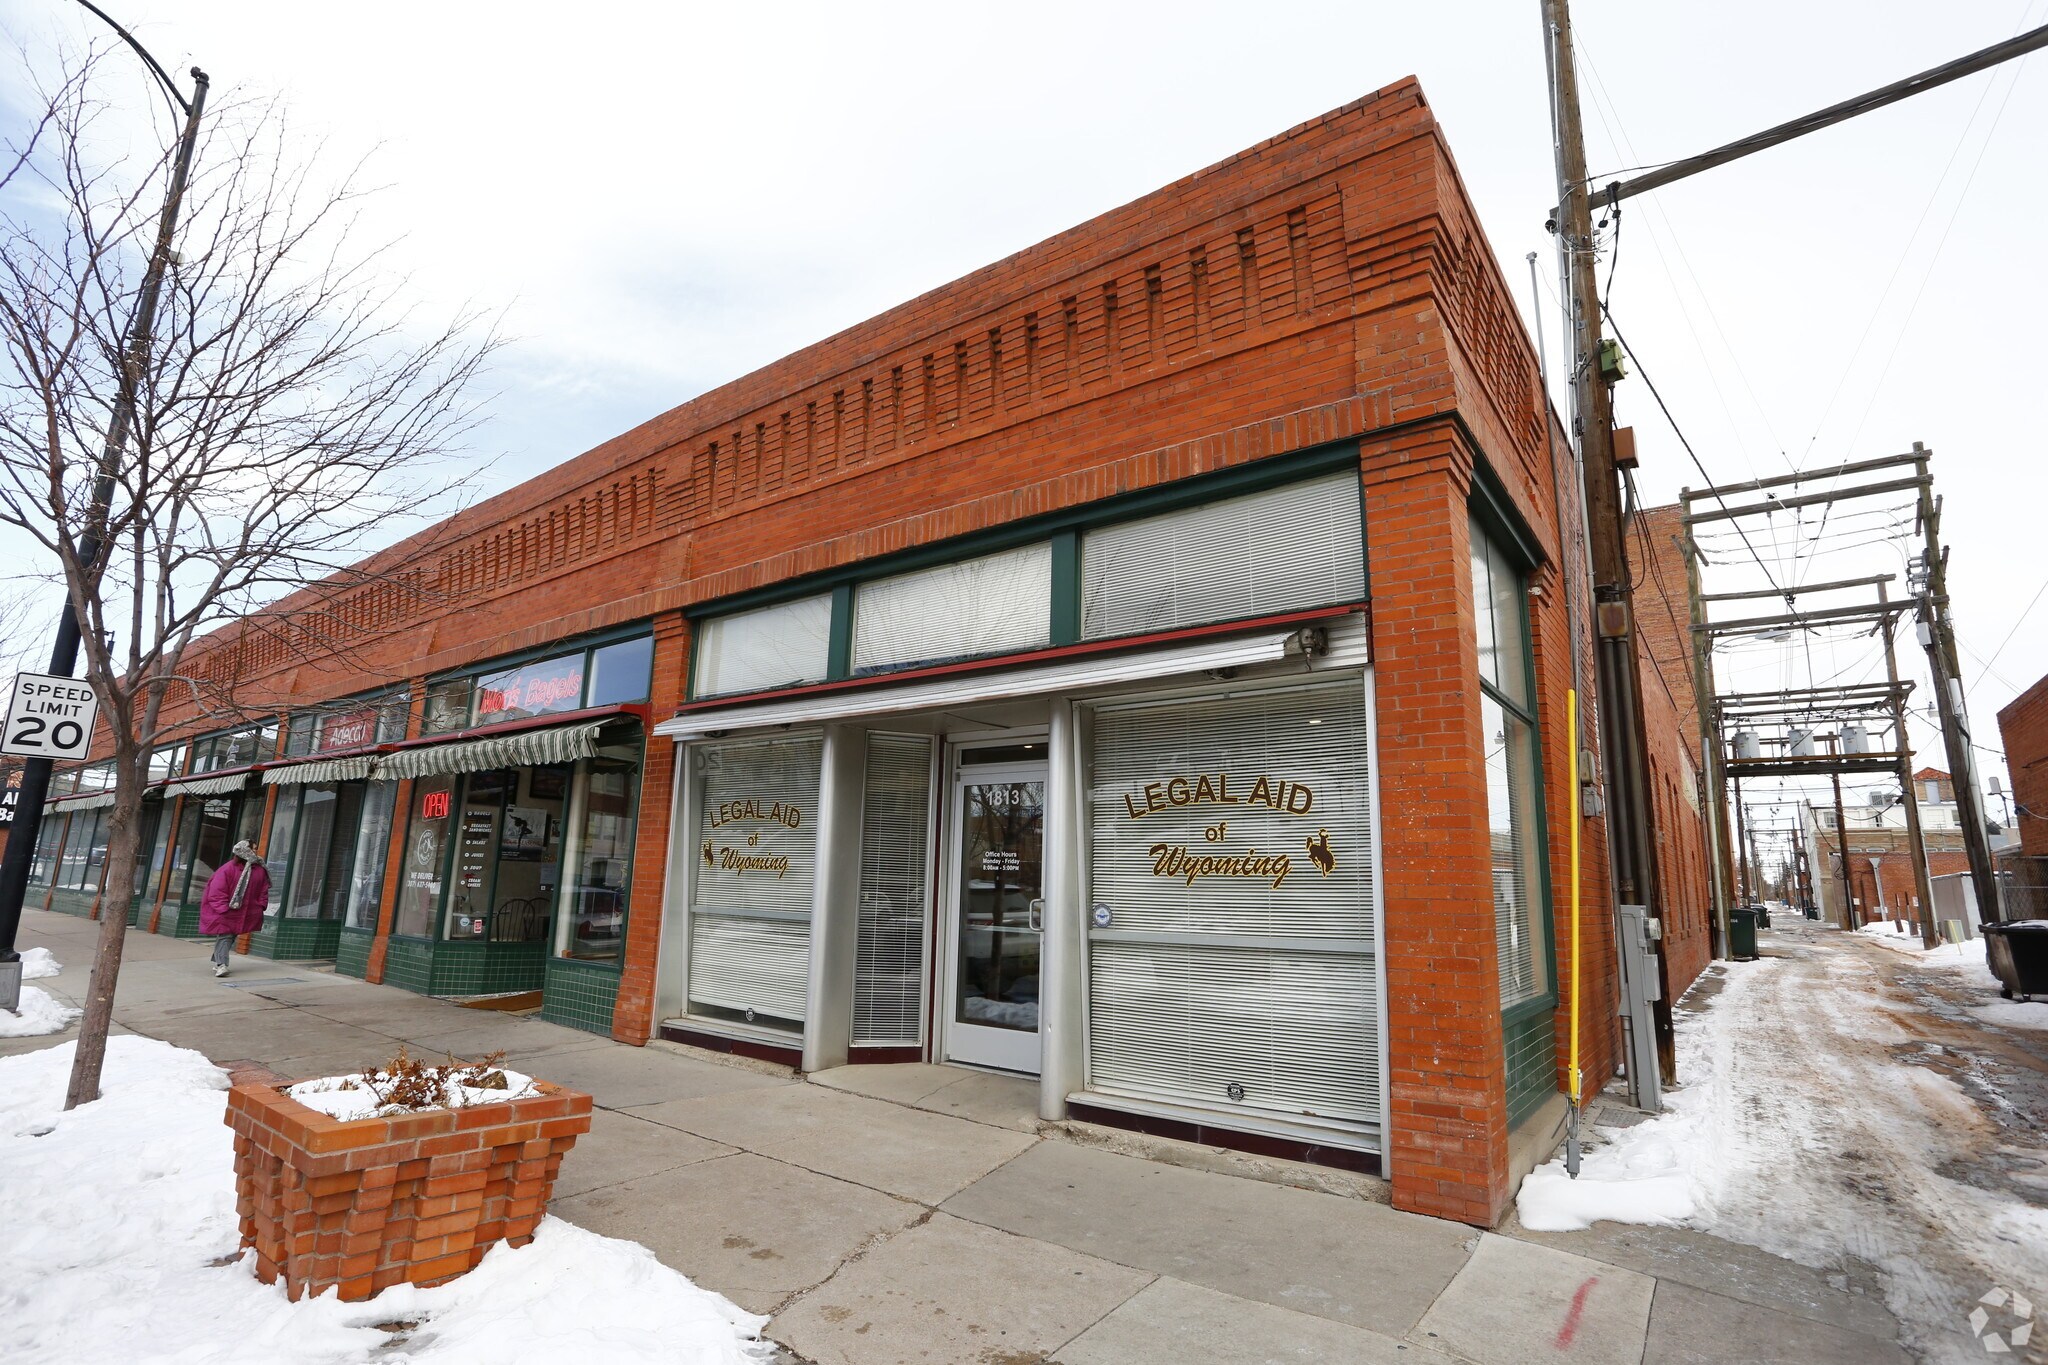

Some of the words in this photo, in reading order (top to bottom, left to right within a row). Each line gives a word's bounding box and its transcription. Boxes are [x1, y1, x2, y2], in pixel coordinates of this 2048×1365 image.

[21, 682, 93, 702] SPEED
[525, 669, 583, 707] Bagels
[25, 700, 83, 717] LIMIT
[10, 716, 84, 750] 20
[1, 791, 20, 805] Al
[423, 792, 449, 818] OPEN
[985, 789, 1020, 806] 1813
[1123, 773, 1239, 820] LEGAL
[1247, 775, 1314, 816] AID
[0, 807, 15, 821] Ba
[709, 799, 765, 829] LEGAL
[769, 801, 801, 829] AID
[747, 832, 759, 847] of
[1204, 821, 1227, 842] of
[719, 846, 789, 880] Wyoming
[1148, 843, 1293, 890] Wyoming
[418, 871, 434, 881] DELIVER
